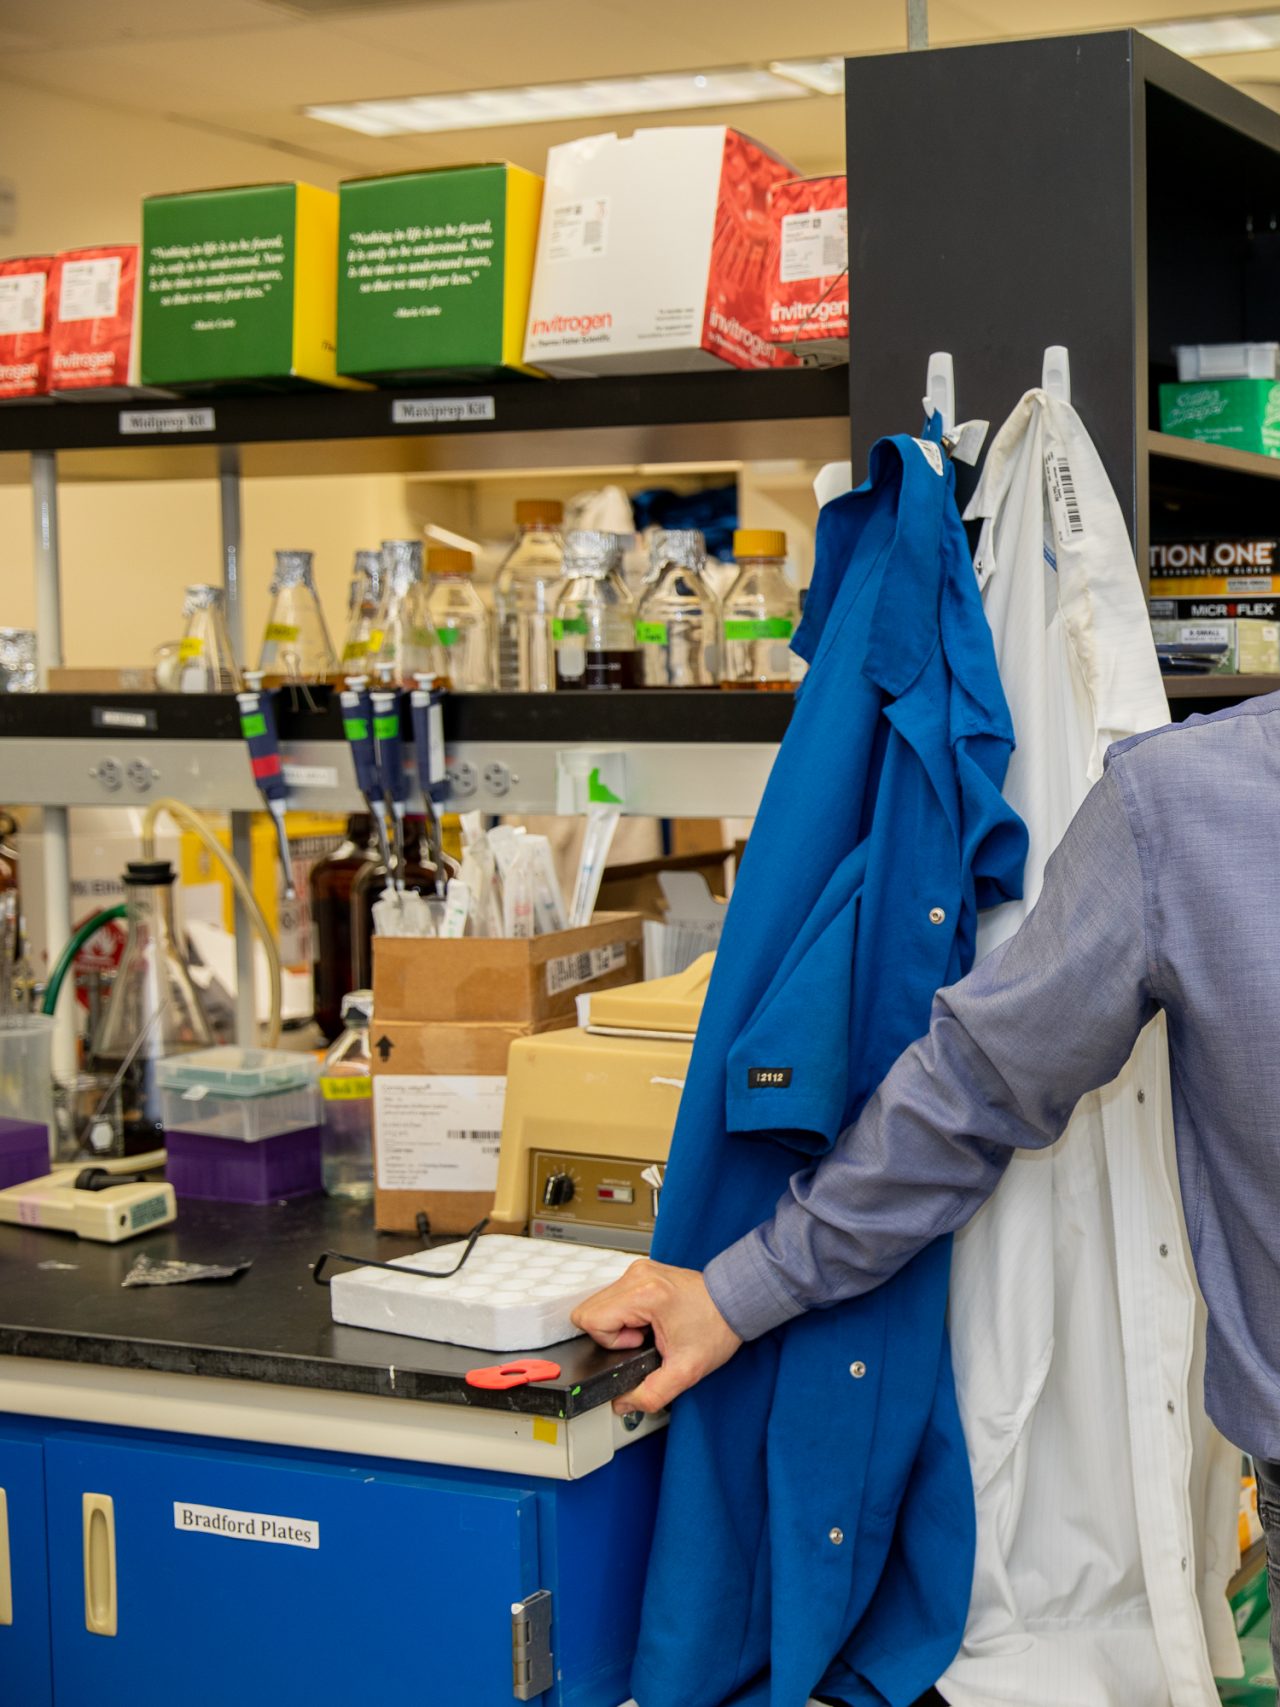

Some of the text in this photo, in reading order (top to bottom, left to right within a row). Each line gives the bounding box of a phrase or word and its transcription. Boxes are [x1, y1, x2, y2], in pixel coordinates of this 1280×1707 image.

[394, 228, 406, 241] in
[406, 226, 421, 242] life
[422, 225, 433, 239] is
[434, 226, 444, 238] to
[445, 222, 458, 237] be
[347, 249, 356, 262] it
[356, 248, 366, 261] is
[366, 246, 387, 262] only
[388, 247, 399, 259] to
[400, 244, 412, 258] be
[470, 237, 494, 250] Now
[347, 265, 358, 278] is
[358, 264, 373, 278] the
[374, 263, 395, 276] time
[396, 263, 408, 274] to
[408, 255, 463, 272] understand
[360, 282, 372, 293] so
[372, 278, 392, 292] that
[393, 280, 406, 290] we
[407, 278, 428, 291] may
[428, 273, 450, 290] fear
[770, 300, 848, 322] invitrogen
[532, 311, 613, 336] invitrogen
[709, 305, 776, 360] invitrogen
[468, 401, 488, 415] Kit
[188, 412, 205, 428] Kit
[1234, 566, 1272, 576] GLOVES
[182, 1509, 312, 1543] Bradford Plates
